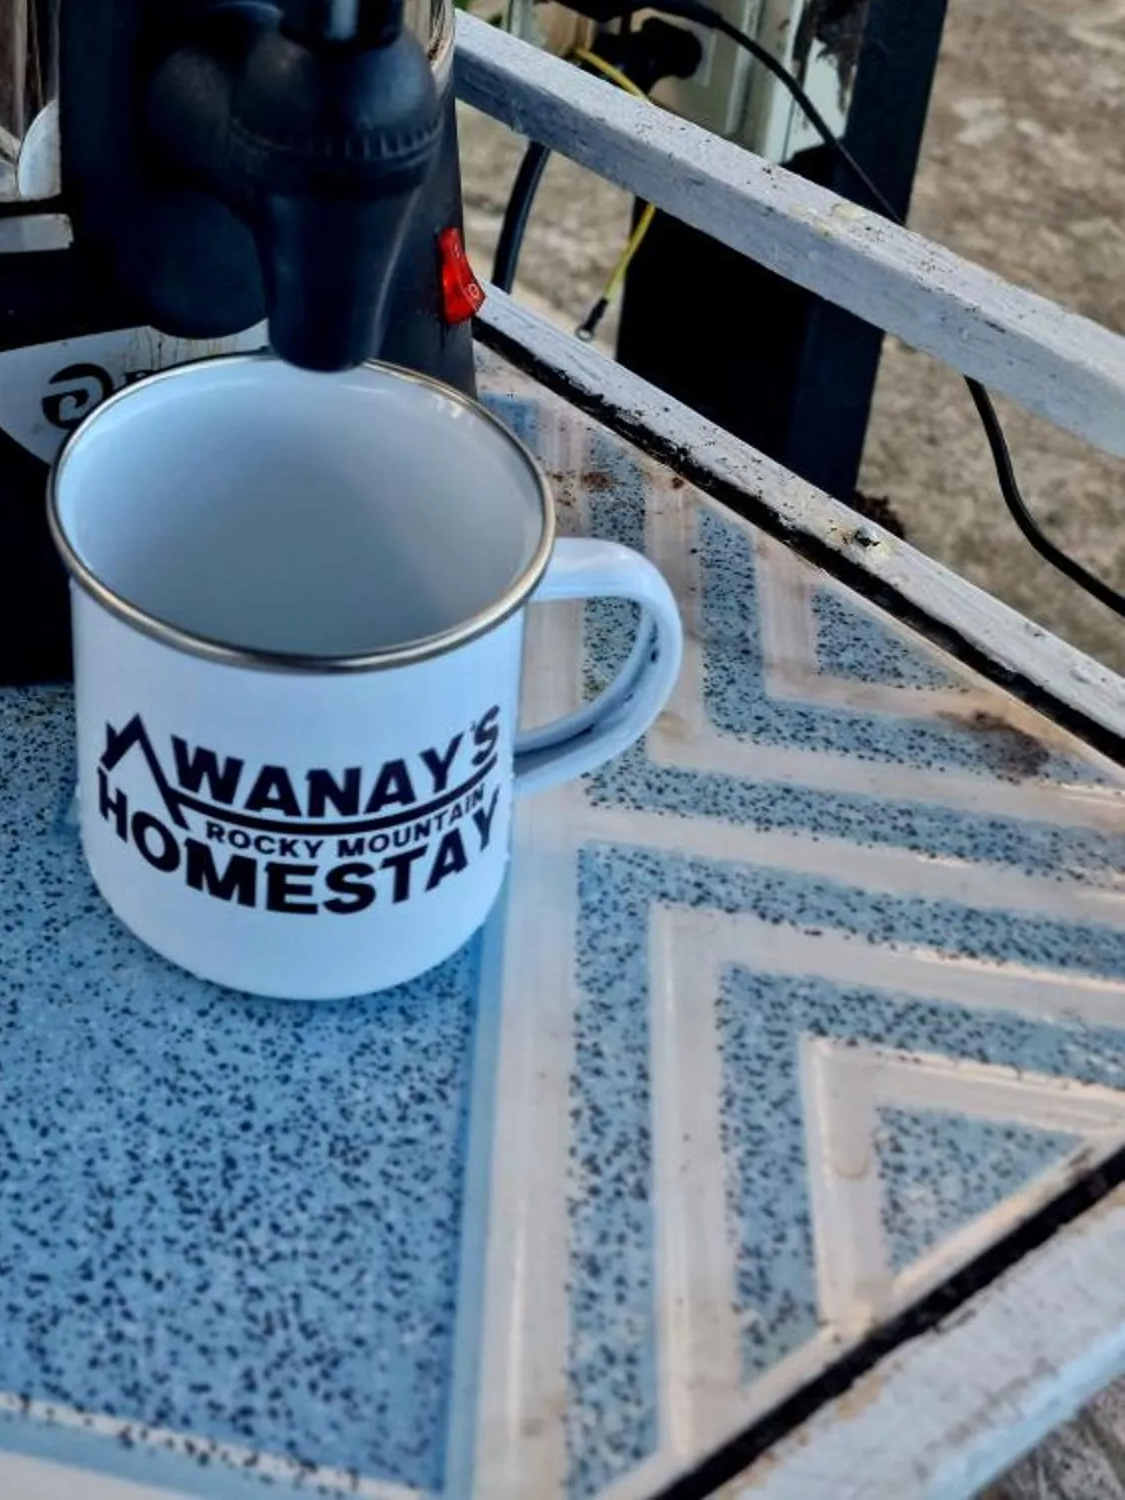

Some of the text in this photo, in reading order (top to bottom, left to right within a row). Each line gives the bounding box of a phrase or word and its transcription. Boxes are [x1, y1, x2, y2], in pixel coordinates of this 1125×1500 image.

[97, 766, 501, 915] HOMESTAY
[205, 783, 486, 860] ROCKY MOUNTAIN
